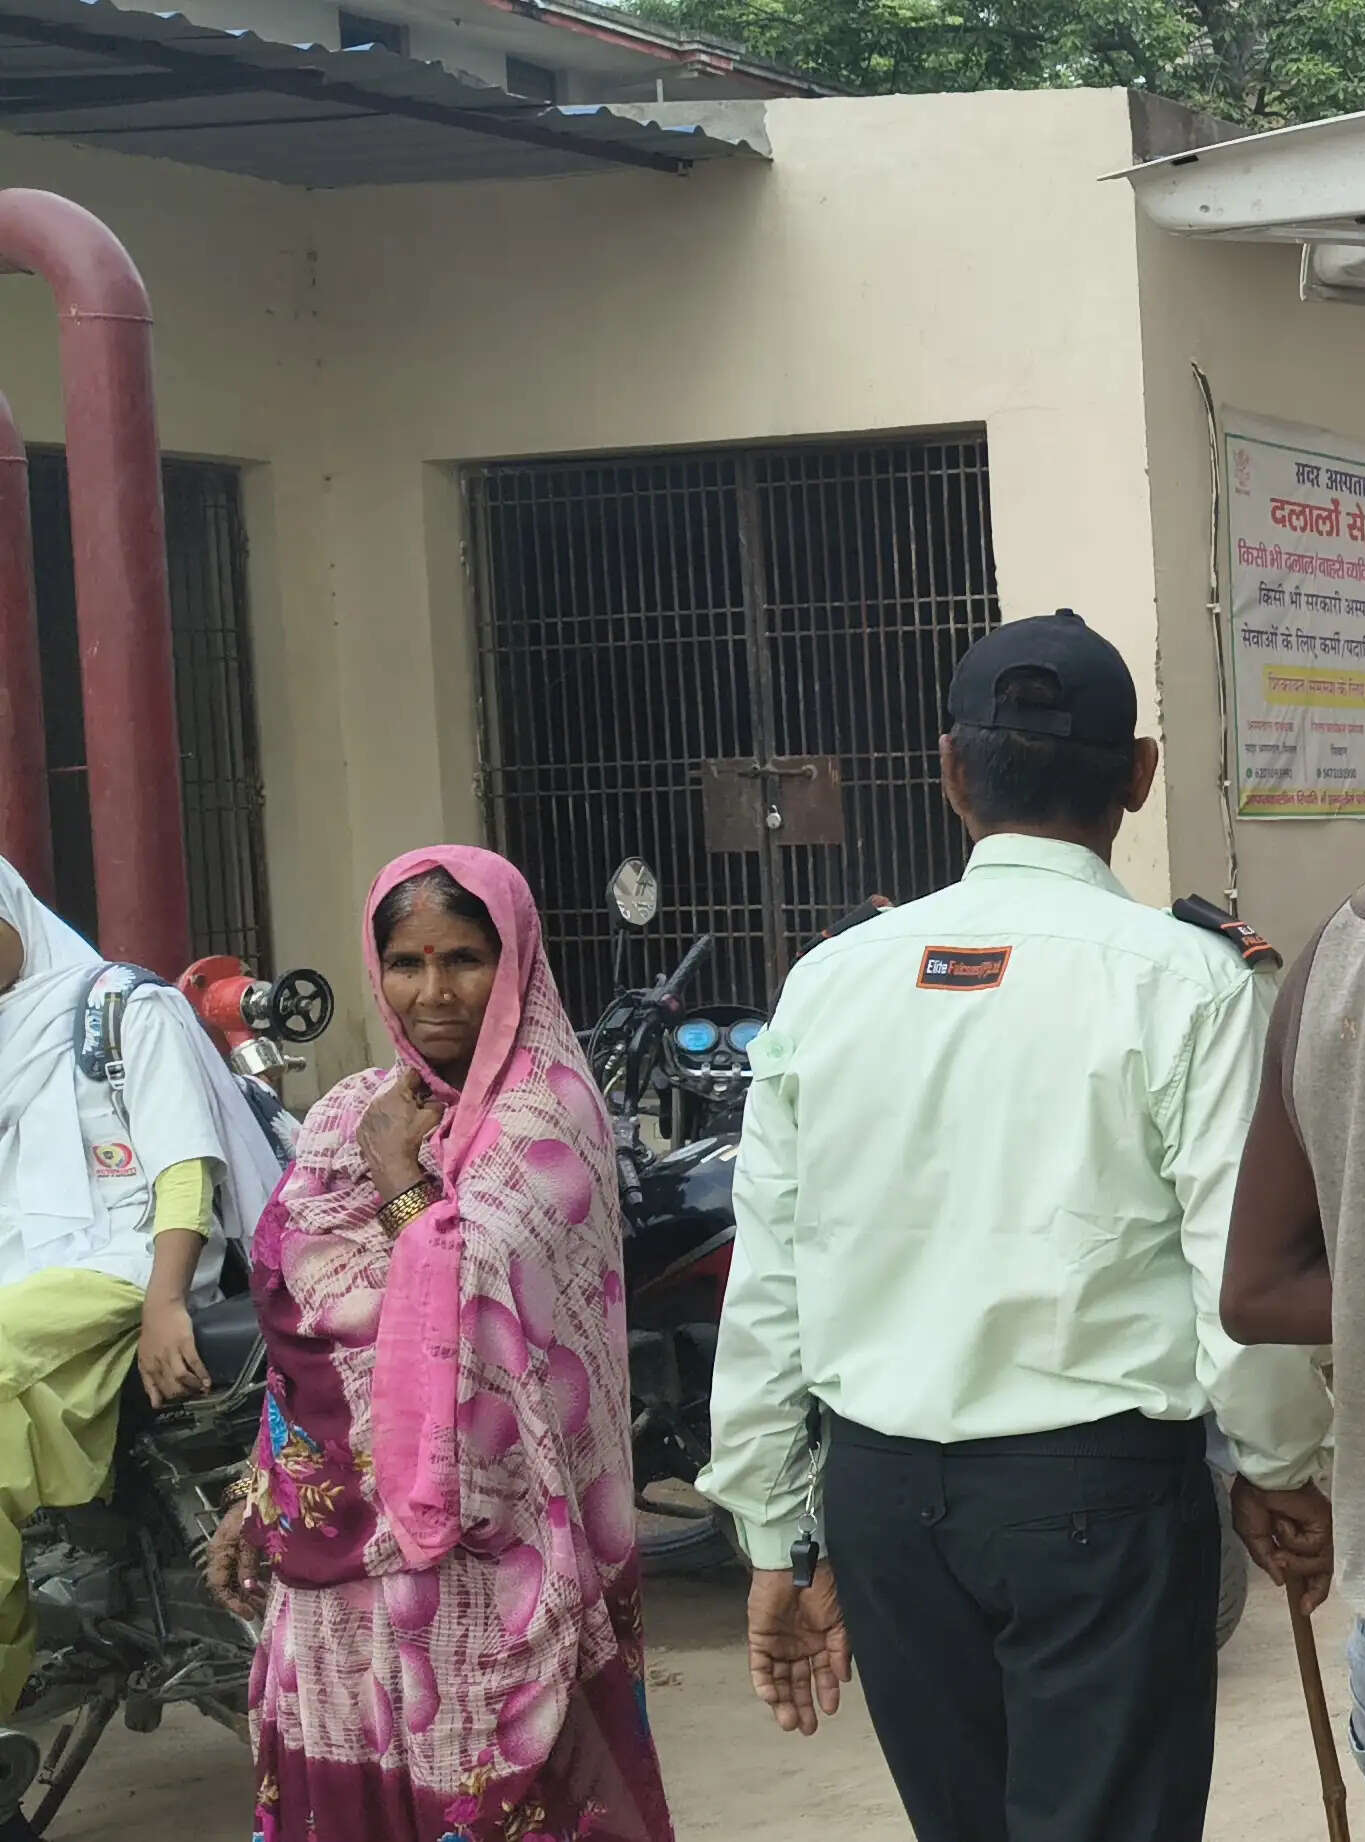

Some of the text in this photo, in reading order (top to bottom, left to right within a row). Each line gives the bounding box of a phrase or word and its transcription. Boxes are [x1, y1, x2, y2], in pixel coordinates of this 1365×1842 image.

[1295, 462, 1321, 489] सदर
[1270, 497, 1341, 537] दलालों
[1346, 502, 1365, 542] से
[1238, 537, 1268, 568] किसी
[1270, 545, 1283, 571] भी
[1258, 581, 1285, 609] किसी
[1289, 585, 1302, 611] भी
[1304, 589, 1342, 616] सरकारी
[1240, 622, 1278, 651] सेवाओं
[1281, 627, 1293, 652] के
[1296, 628, 1318, 660] लिए
